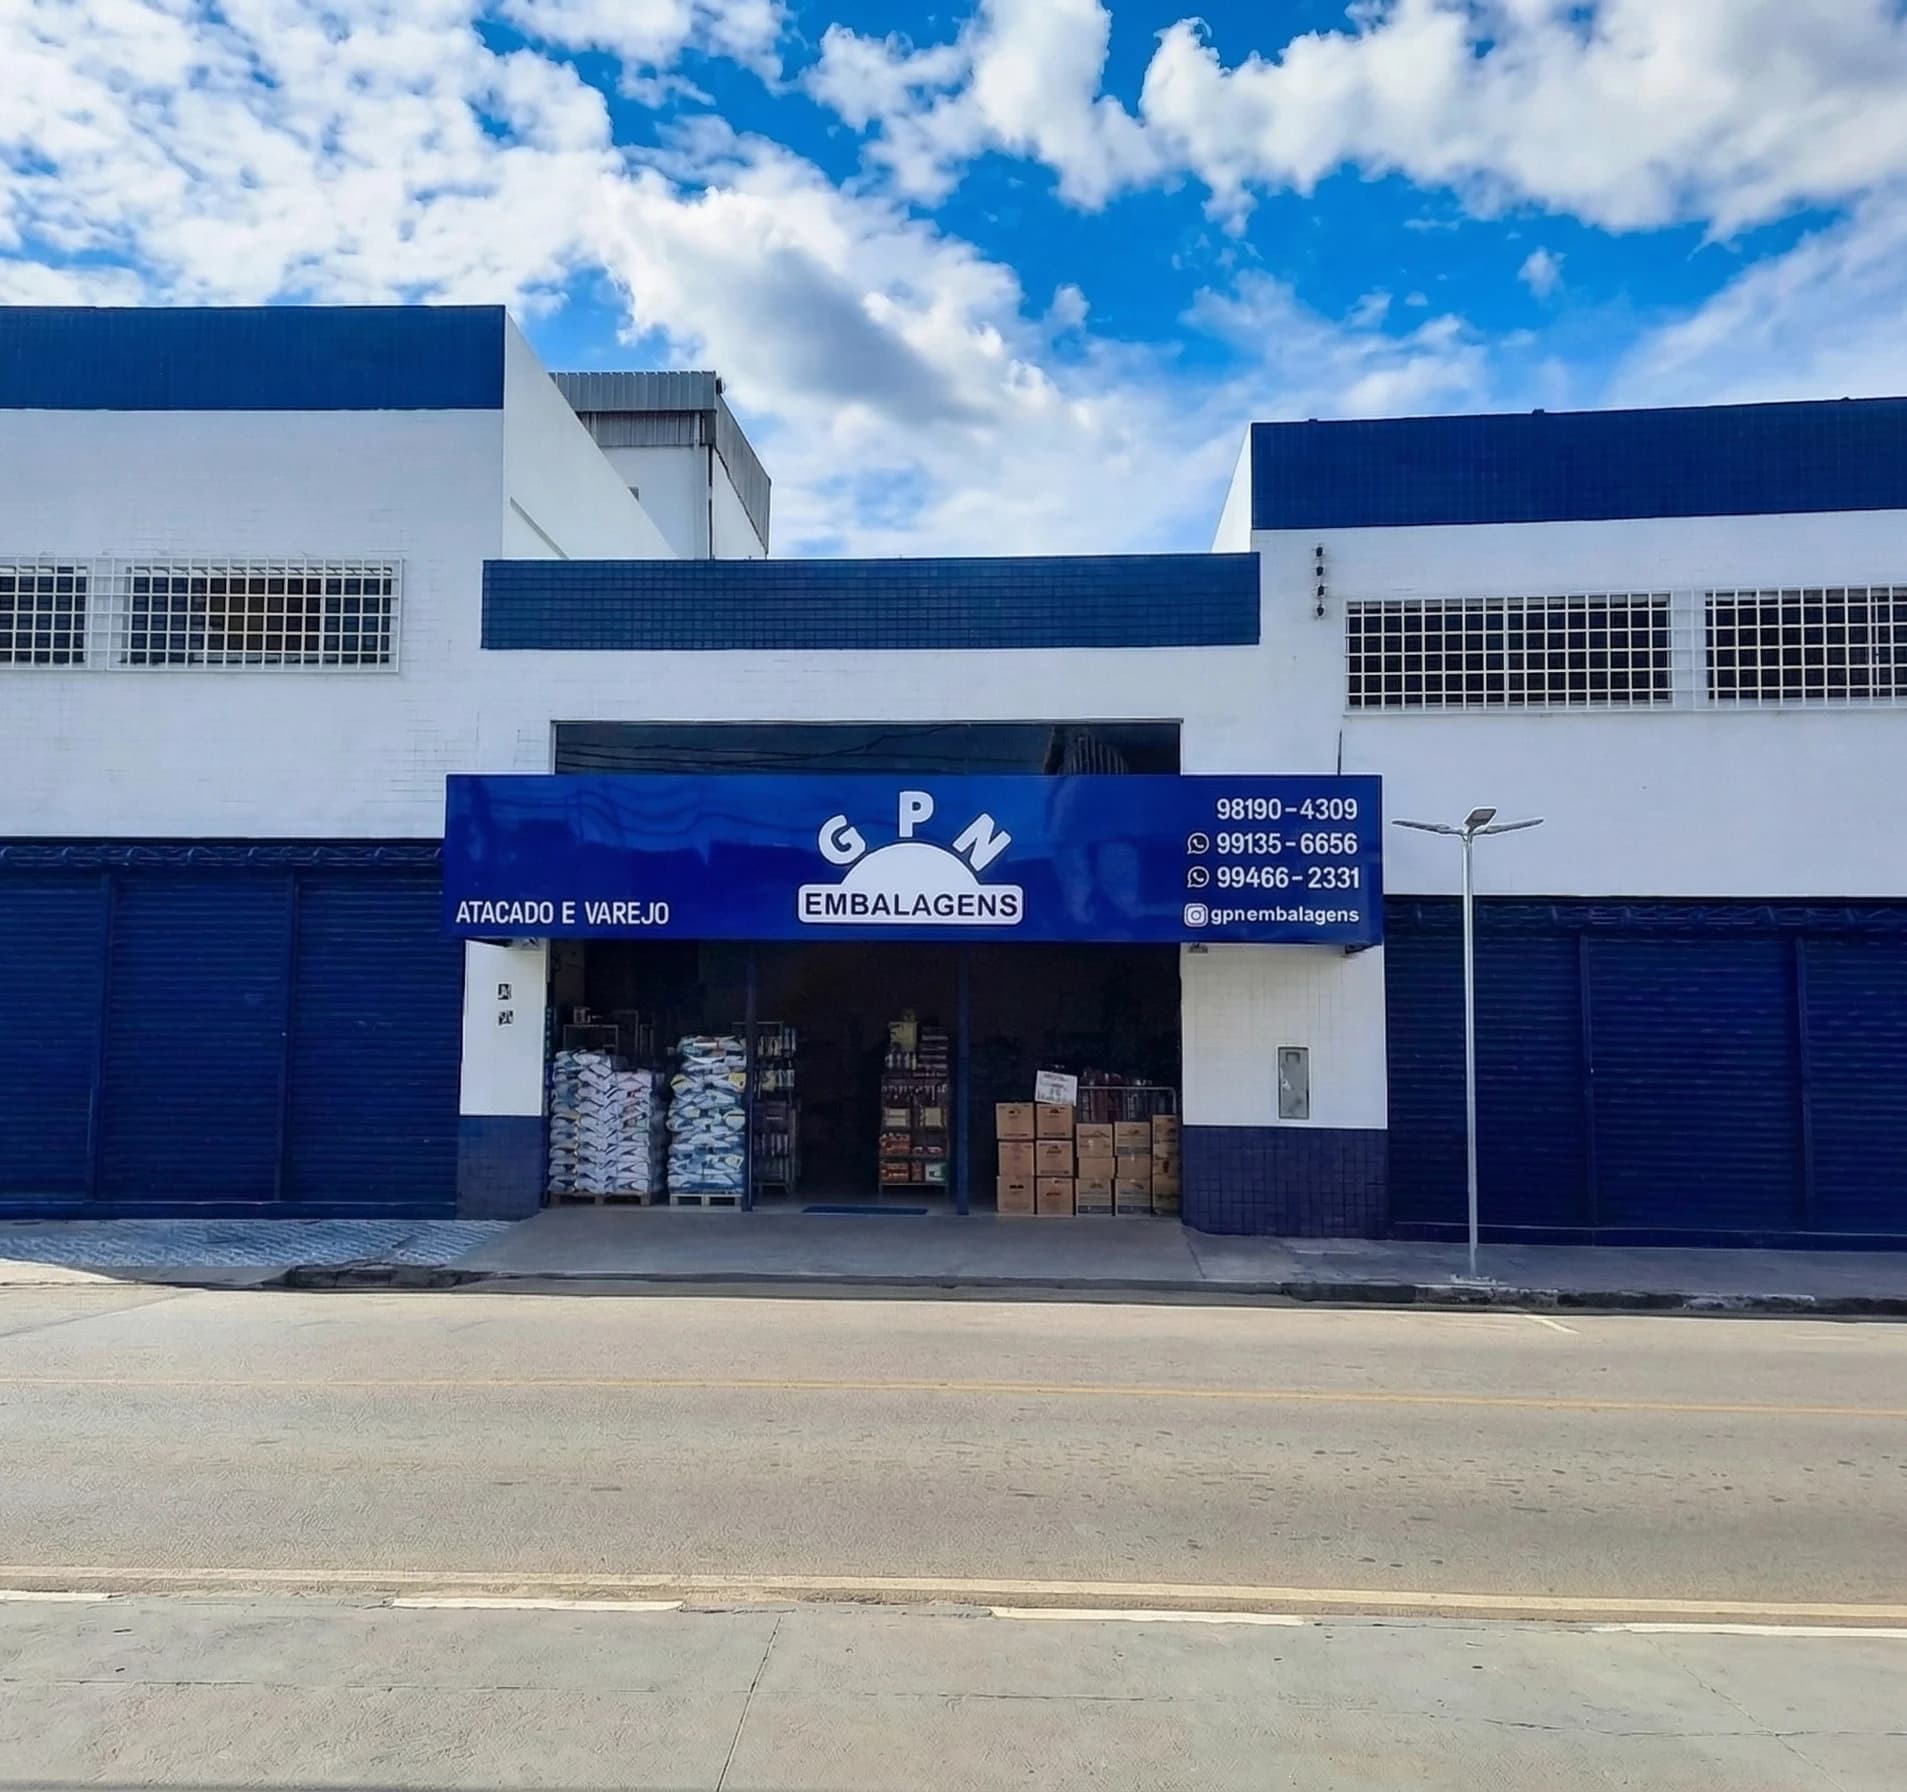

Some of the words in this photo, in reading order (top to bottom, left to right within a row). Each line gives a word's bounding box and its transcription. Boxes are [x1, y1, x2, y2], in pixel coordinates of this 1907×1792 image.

[455, 901, 554, 924] ATACADO
[562, 902, 575, 924] E
[585, 901, 669, 924] VAREJO
[805, 892, 1018, 916] EMBALAGENS
[1211, 906, 1360, 925] gpnembalagens
